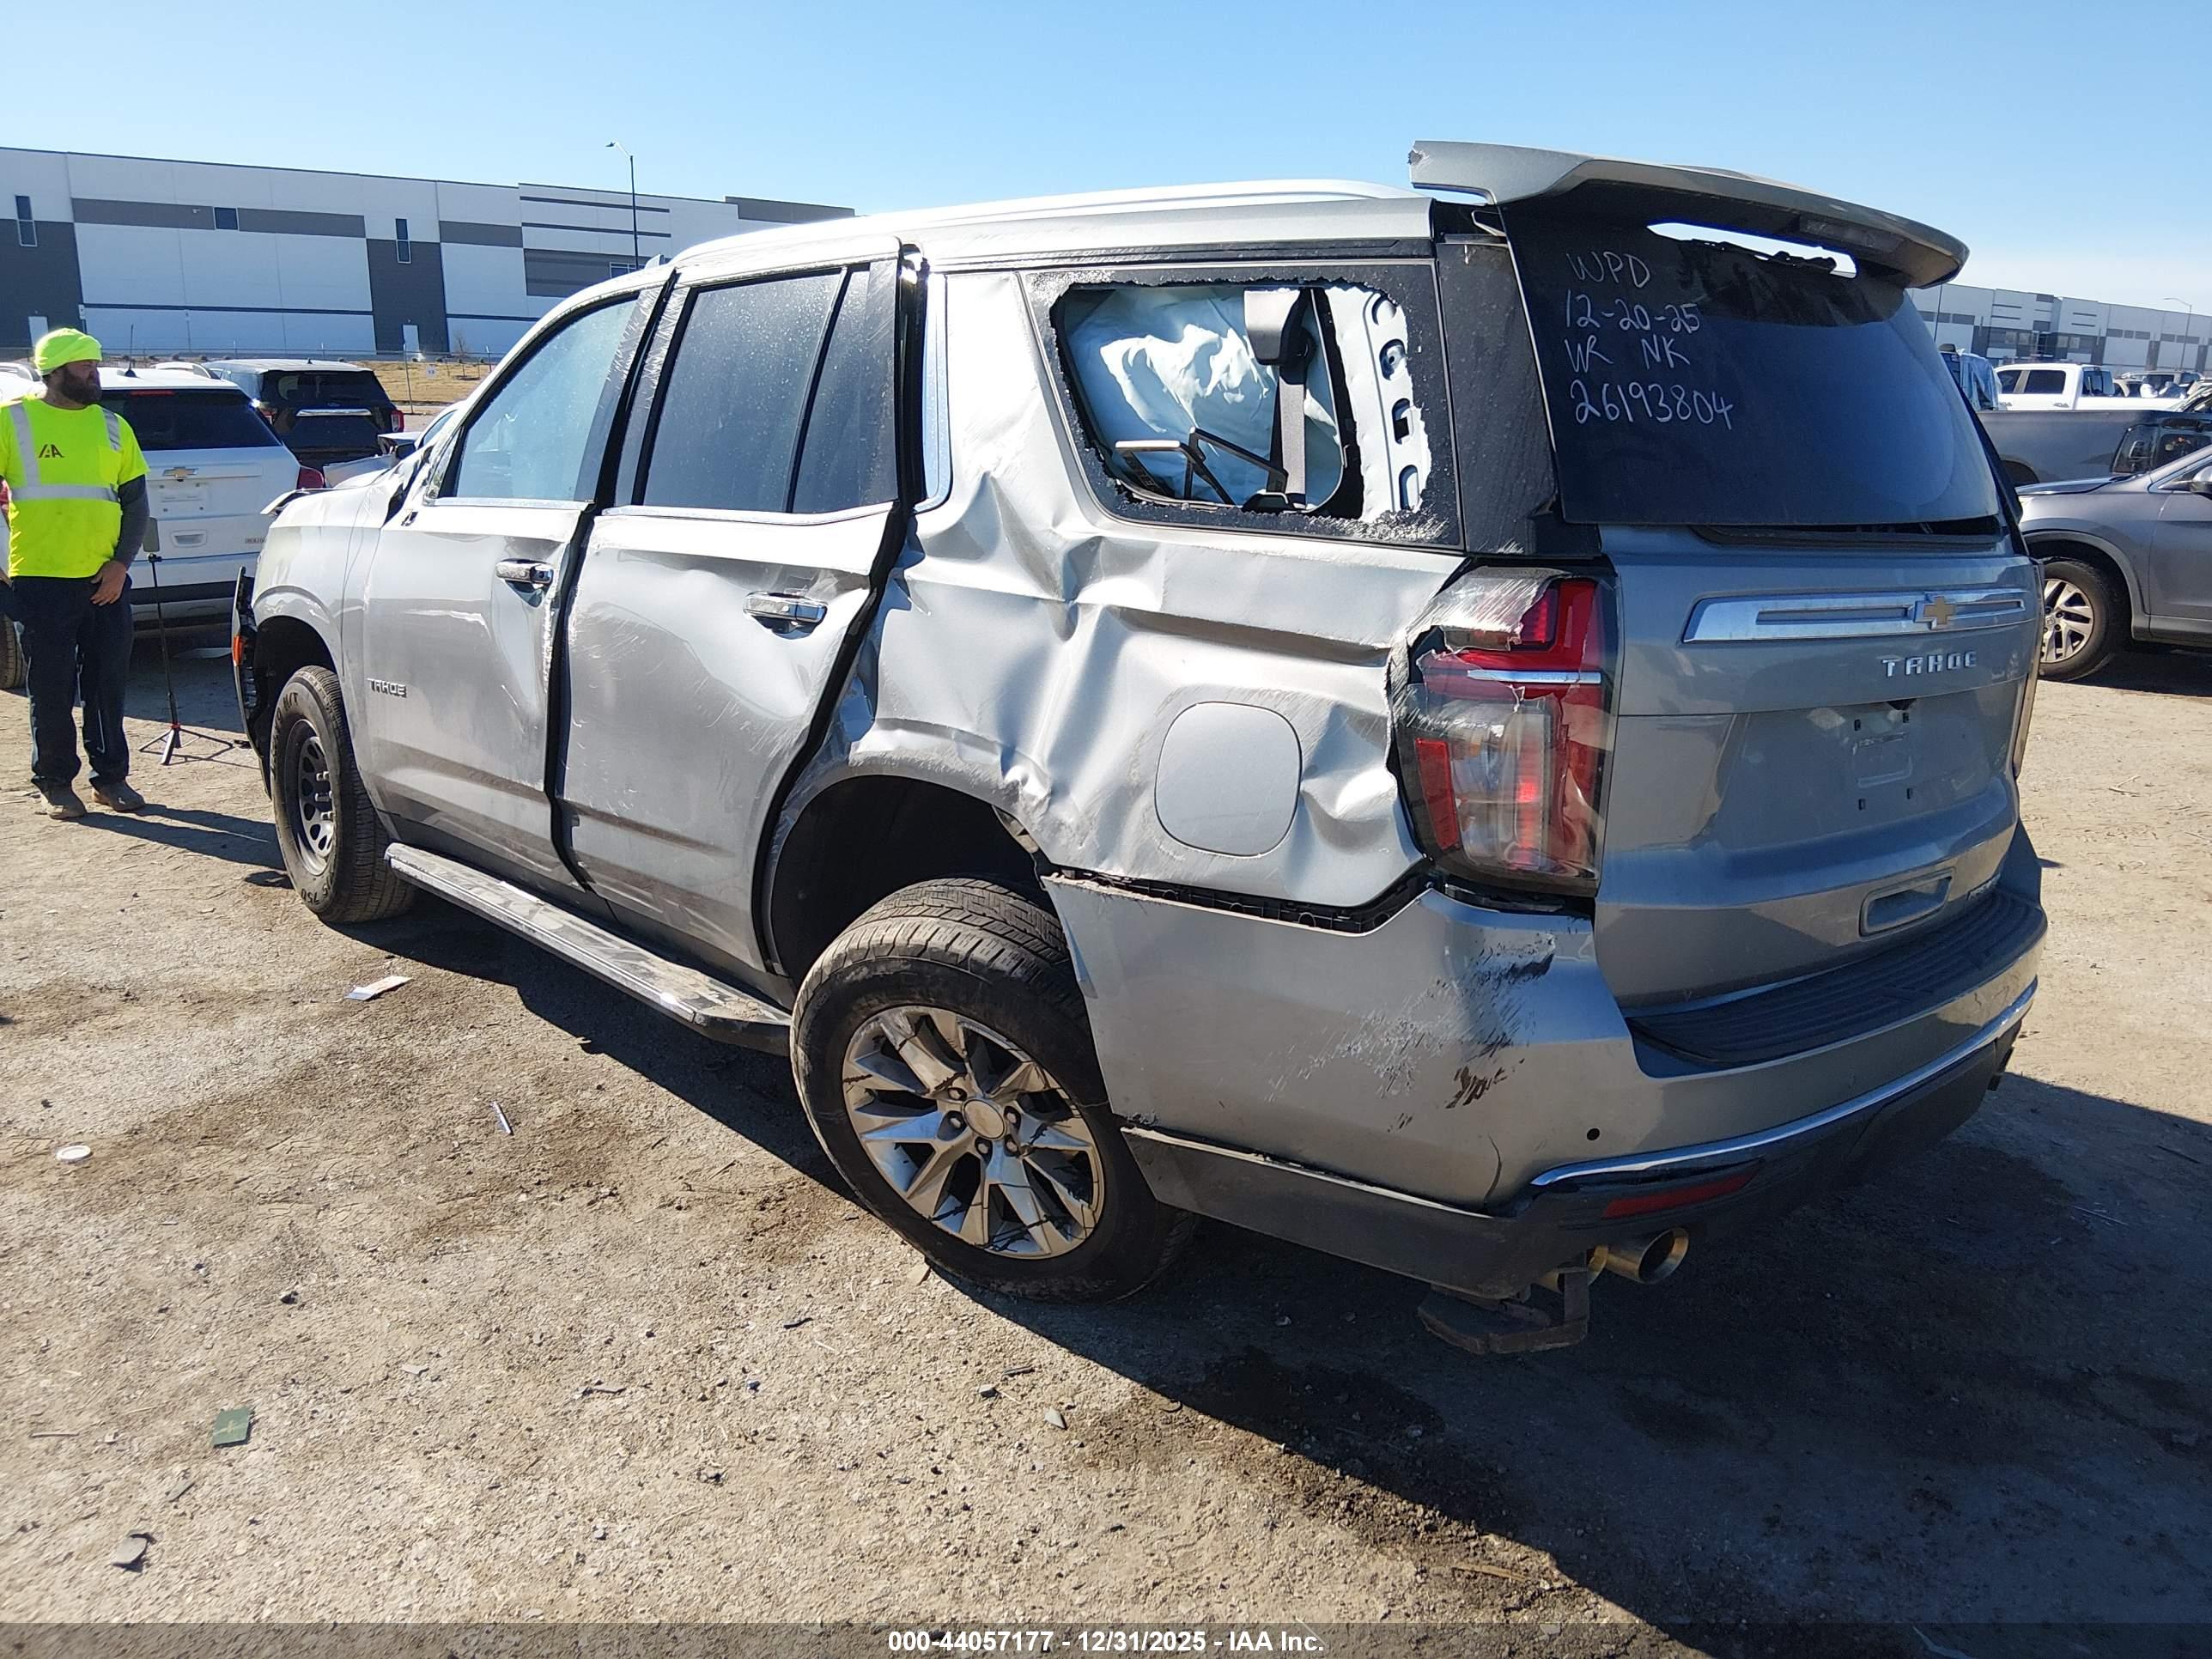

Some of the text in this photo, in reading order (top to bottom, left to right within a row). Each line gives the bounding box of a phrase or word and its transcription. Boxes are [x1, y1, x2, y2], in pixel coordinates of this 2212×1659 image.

[1565, 251, 1650, 289] WPD
[1566, 289, 1700, 334] 12-20-25
[1564, 333, 1691, 373] WR NK
[1570, 379, 1734, 430] 26193804
[1881, 651, 1977, 678] TAHOE
[367, 678, 406, 698] TAHOE
